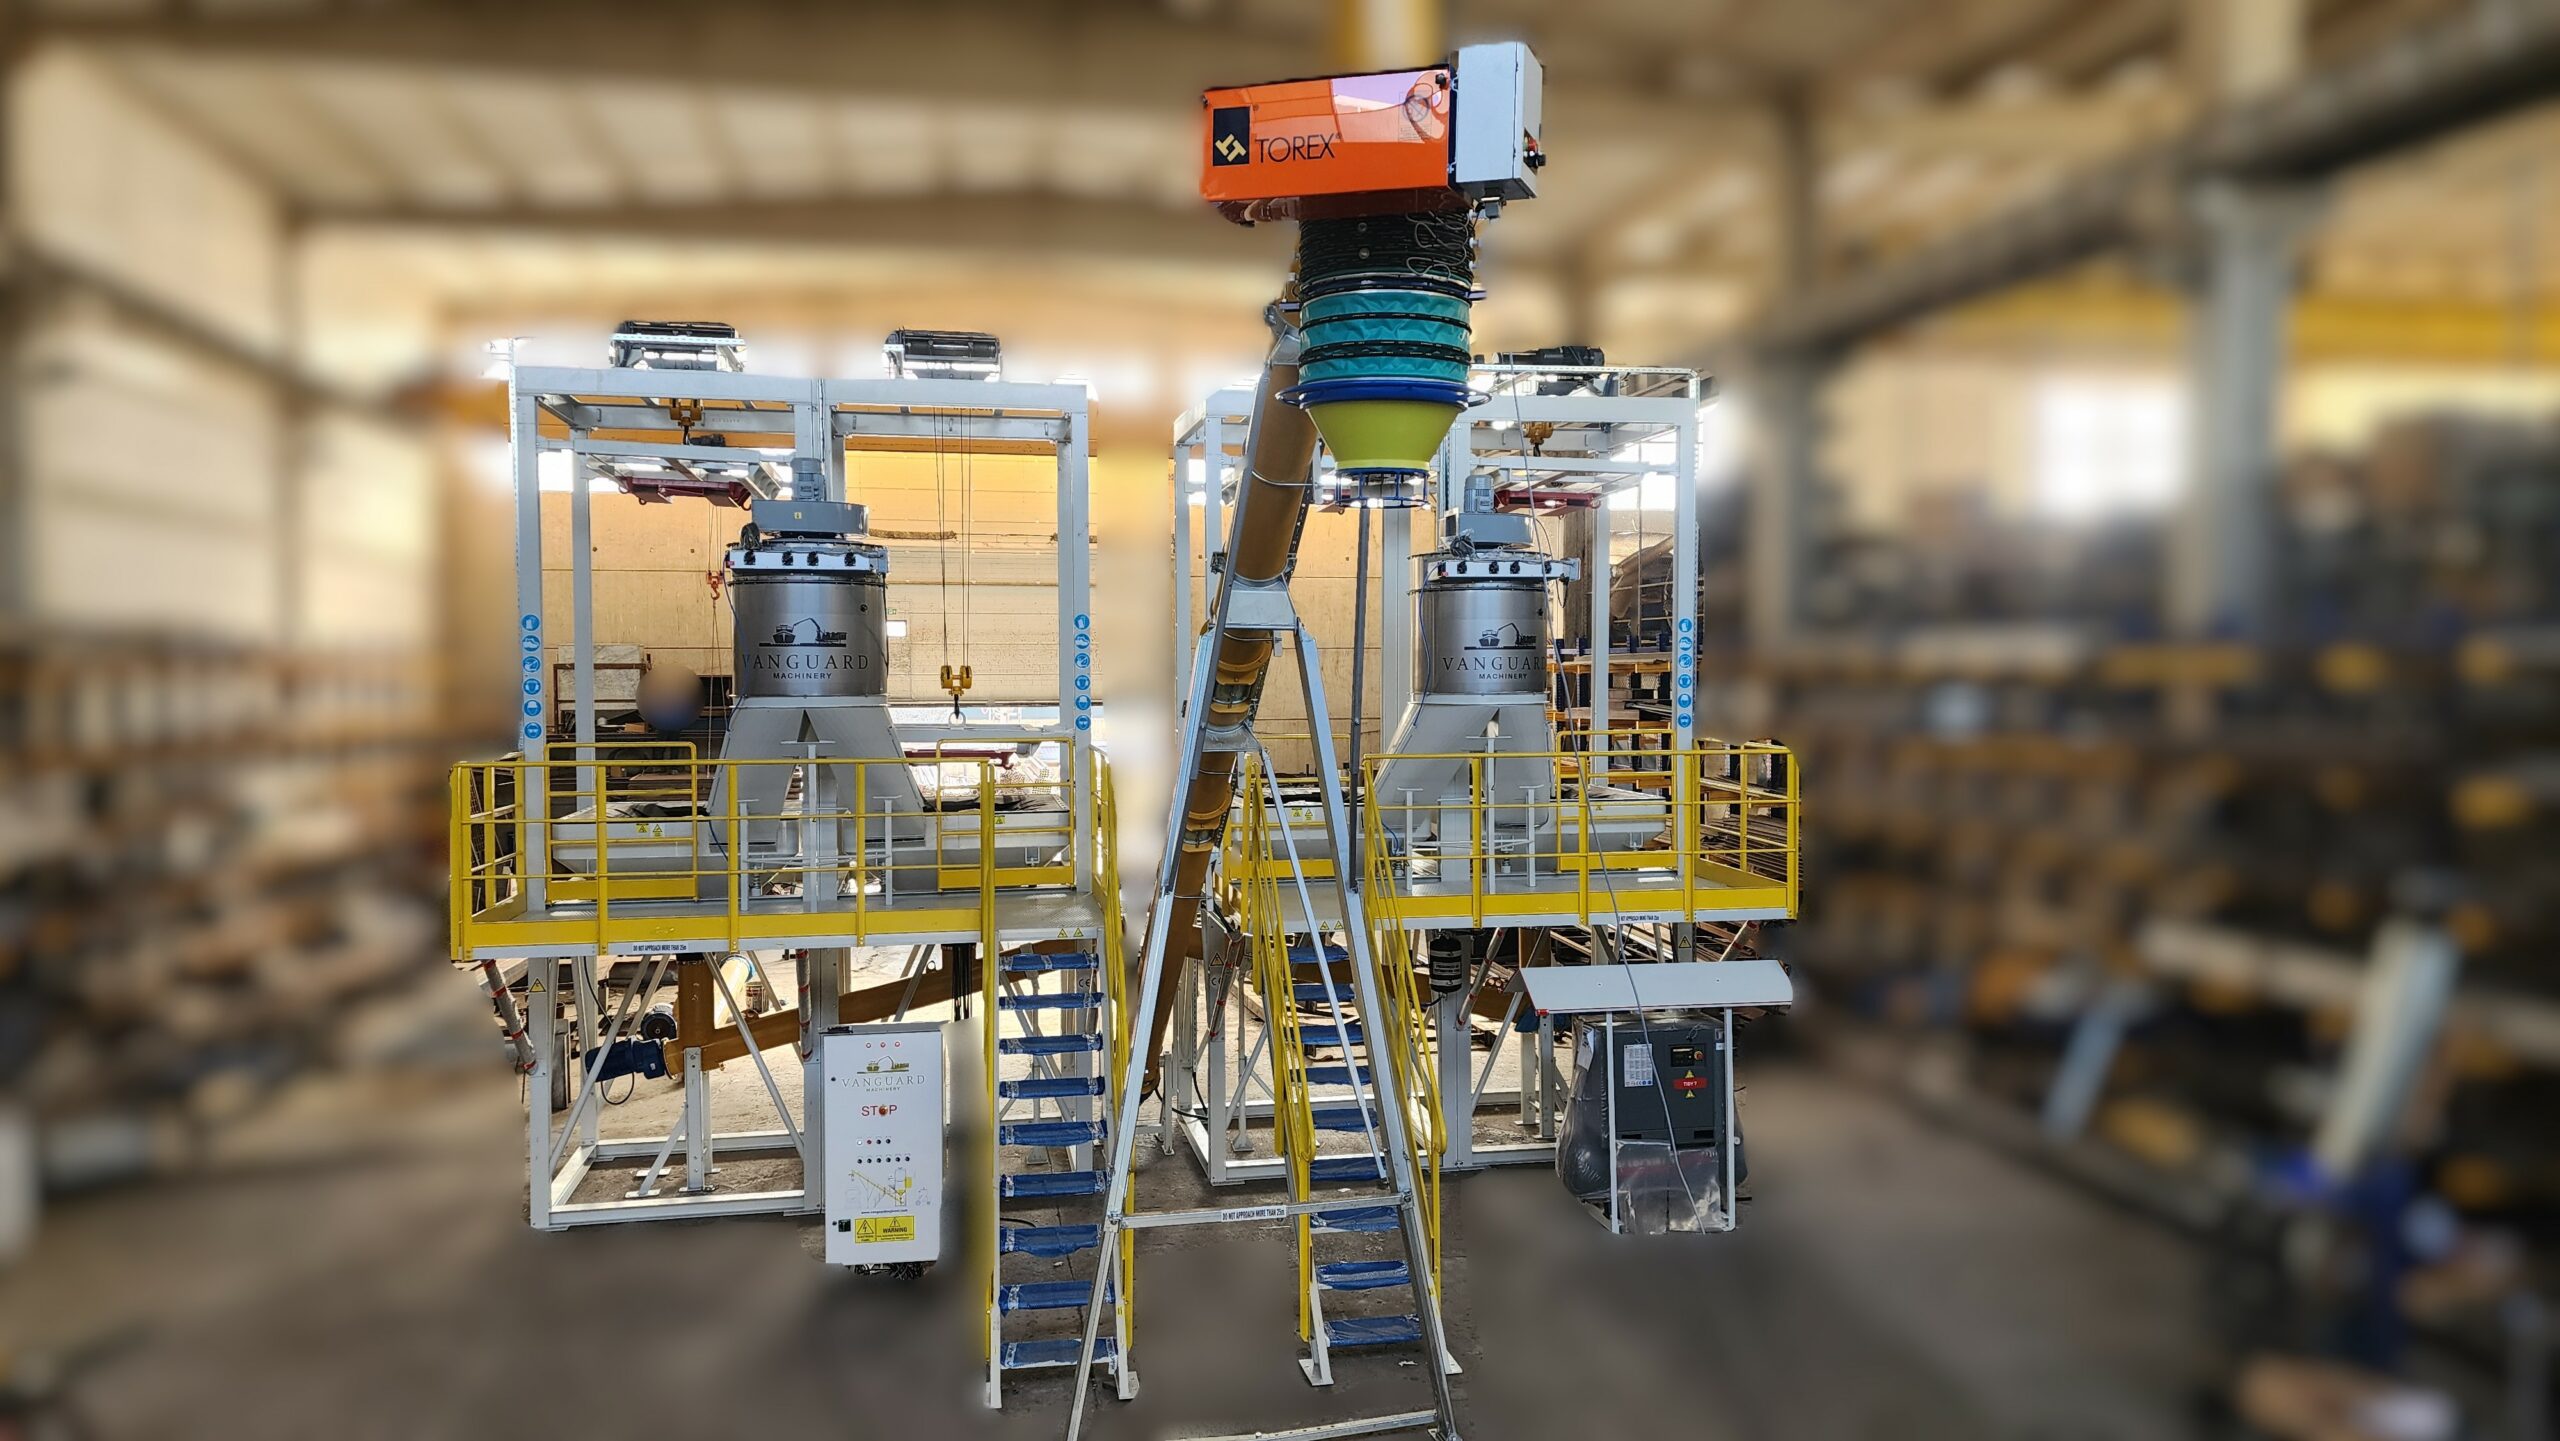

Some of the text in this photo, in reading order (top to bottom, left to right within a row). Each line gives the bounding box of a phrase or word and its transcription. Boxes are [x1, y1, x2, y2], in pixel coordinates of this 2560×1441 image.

[742, 654, 868, 670] VANGUARD
[841, 1074, 925, 1088] VANGUARD
[861, 1104, 898, 1117] STOP
[1236, 1210, 1255, 1220] APPROACH
[1255, 1209, 1266, 1217] MORE
[1266, 1208, 1276, 1217] THAN
[1276, 1208, 1285, 1216] 25m
